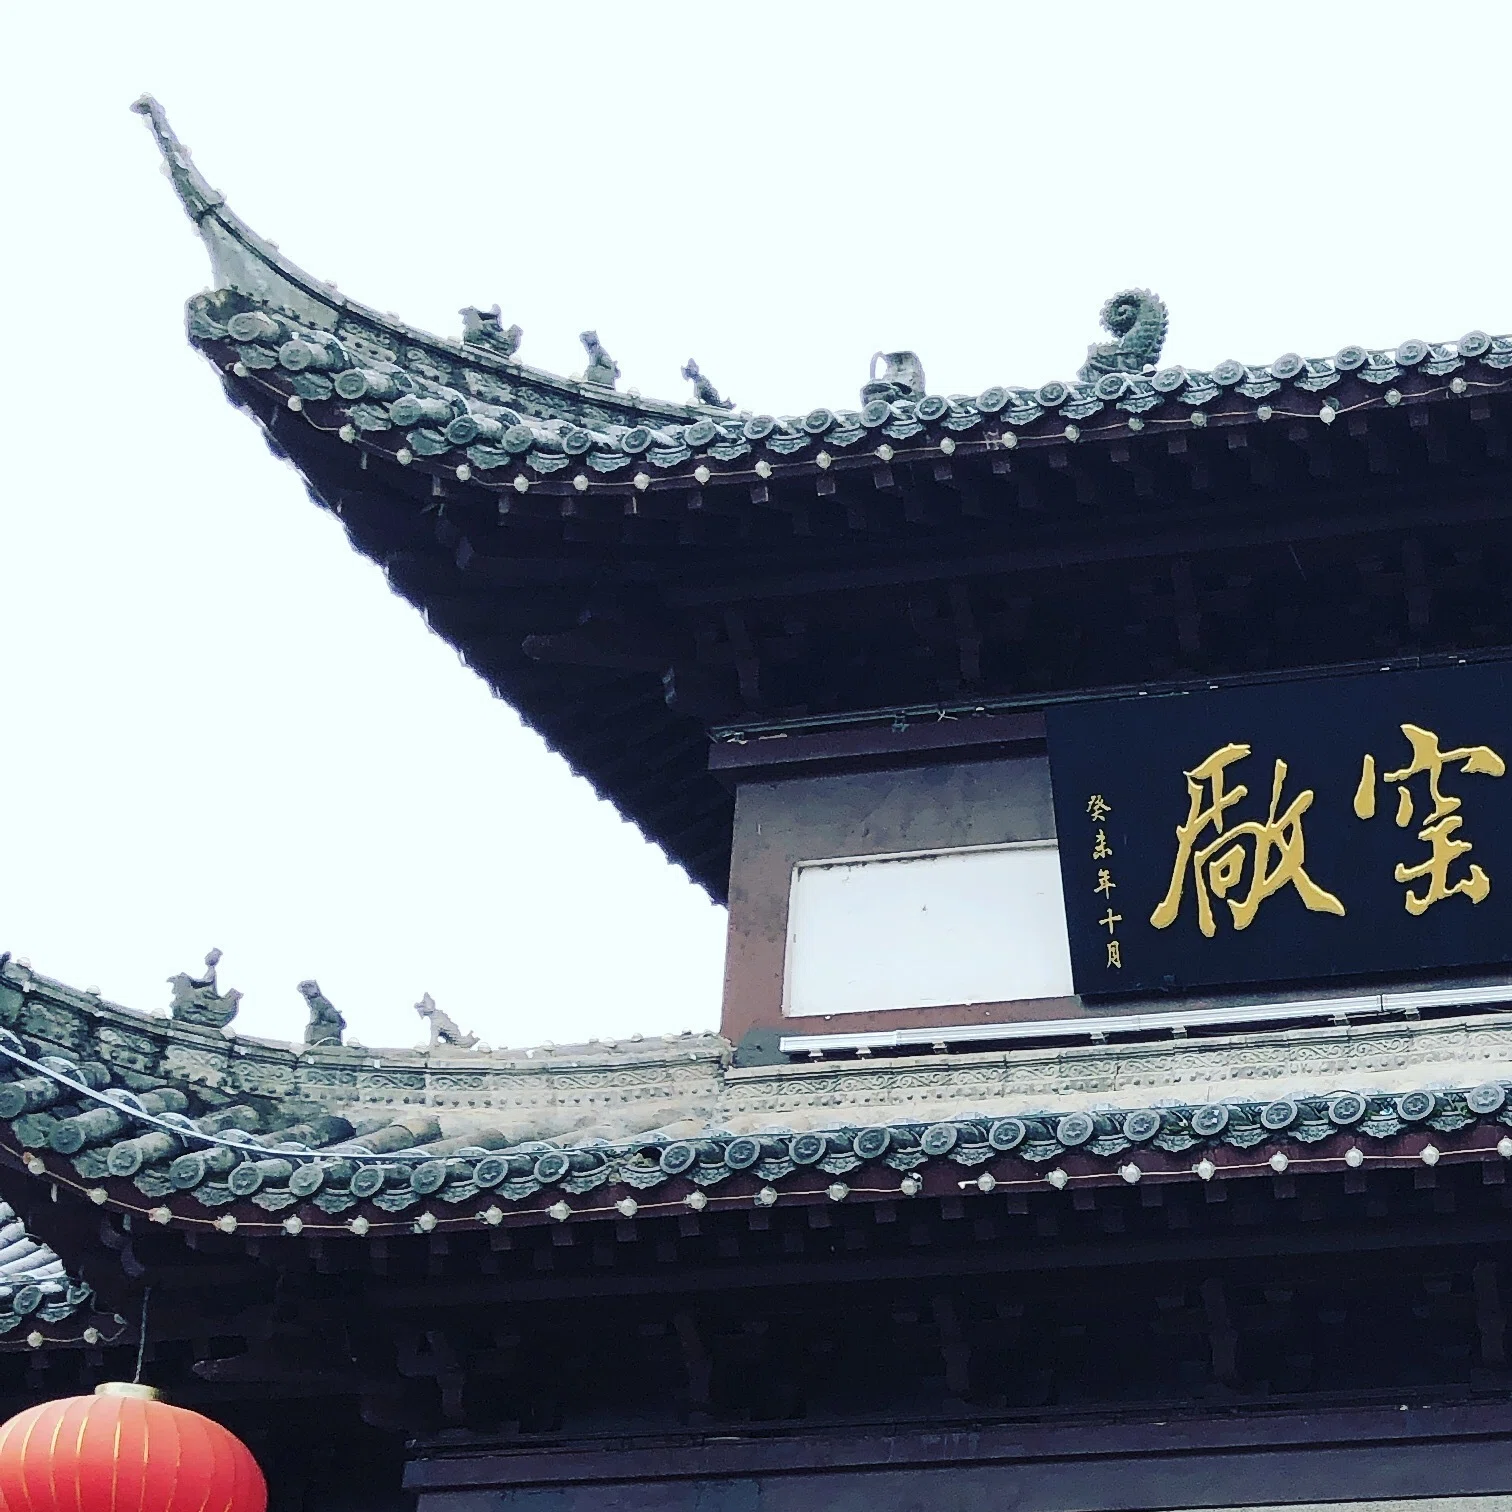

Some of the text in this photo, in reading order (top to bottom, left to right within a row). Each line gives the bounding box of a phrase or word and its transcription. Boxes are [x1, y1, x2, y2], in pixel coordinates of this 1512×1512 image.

[1086, 794, 1122, 969] 癸未年十月
